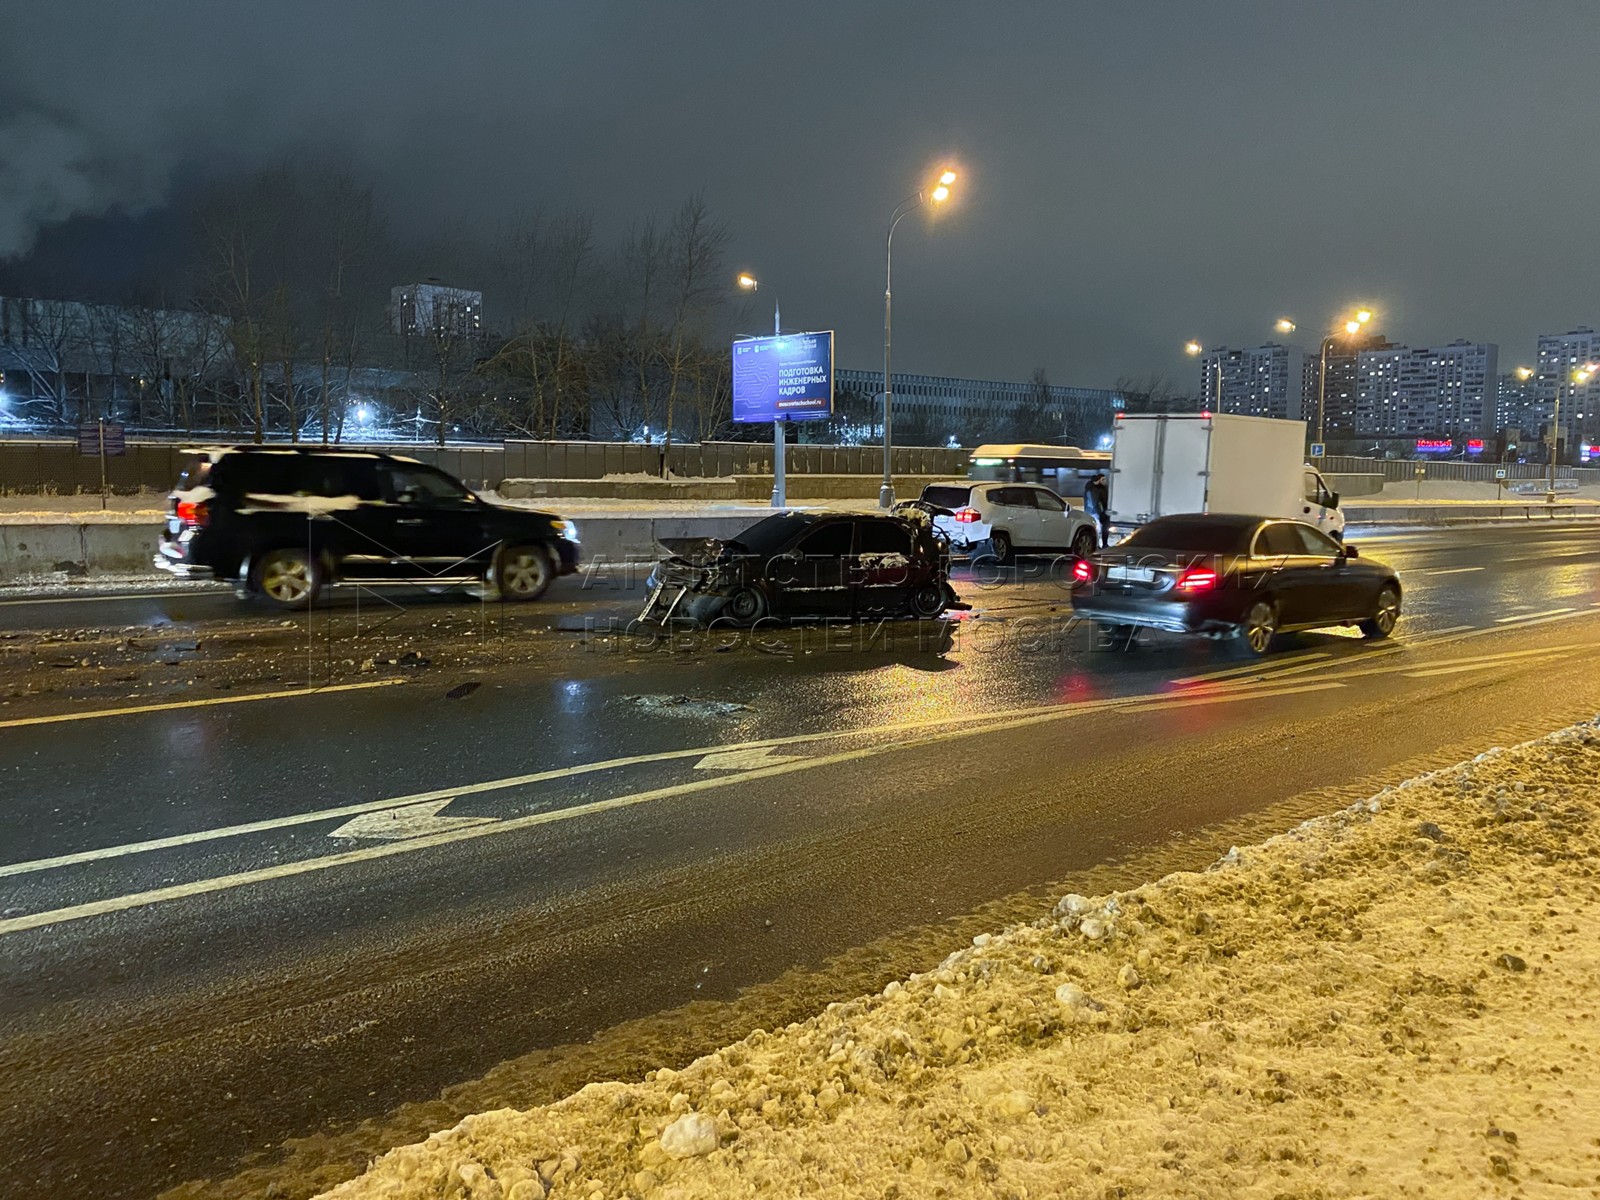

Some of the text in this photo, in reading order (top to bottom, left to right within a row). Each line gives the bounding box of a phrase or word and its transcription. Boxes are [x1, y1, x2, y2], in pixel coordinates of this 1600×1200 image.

[779, 366, 823, 377] ПОДГОТОВКА
[779, 376, 827, 386] ИНЖЕНЕРНЫХ
[779, 386, 806, 396] КАДРОВ
